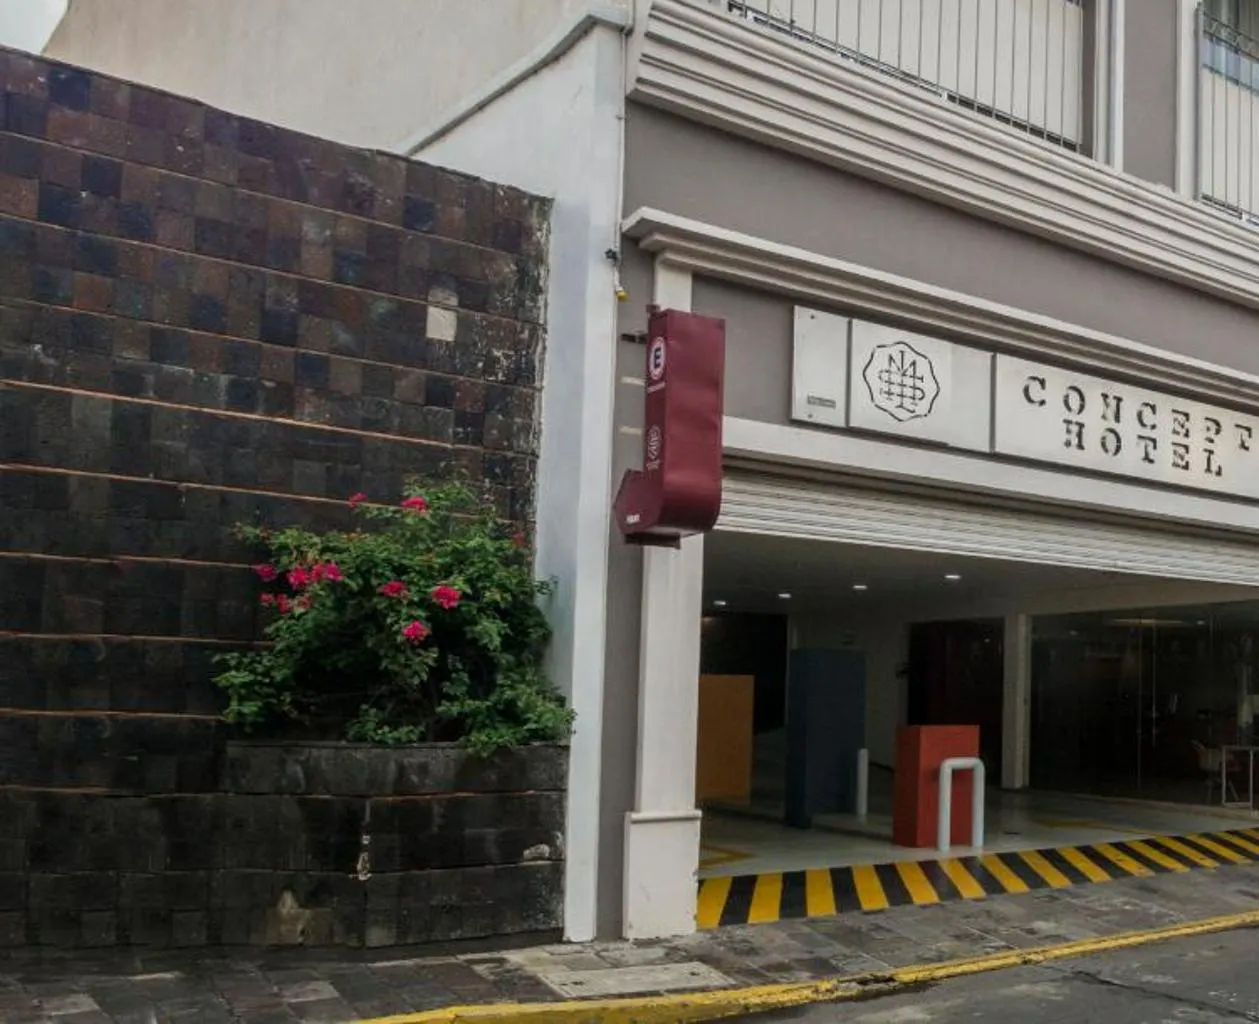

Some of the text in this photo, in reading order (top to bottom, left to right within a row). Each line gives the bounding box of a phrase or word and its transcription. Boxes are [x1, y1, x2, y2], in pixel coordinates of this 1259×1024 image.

[654, 347, 662, 370] E
[1023, 376, 1253, 451] CONCEPT
[1062, 418, 1222, 476] HOTEL
